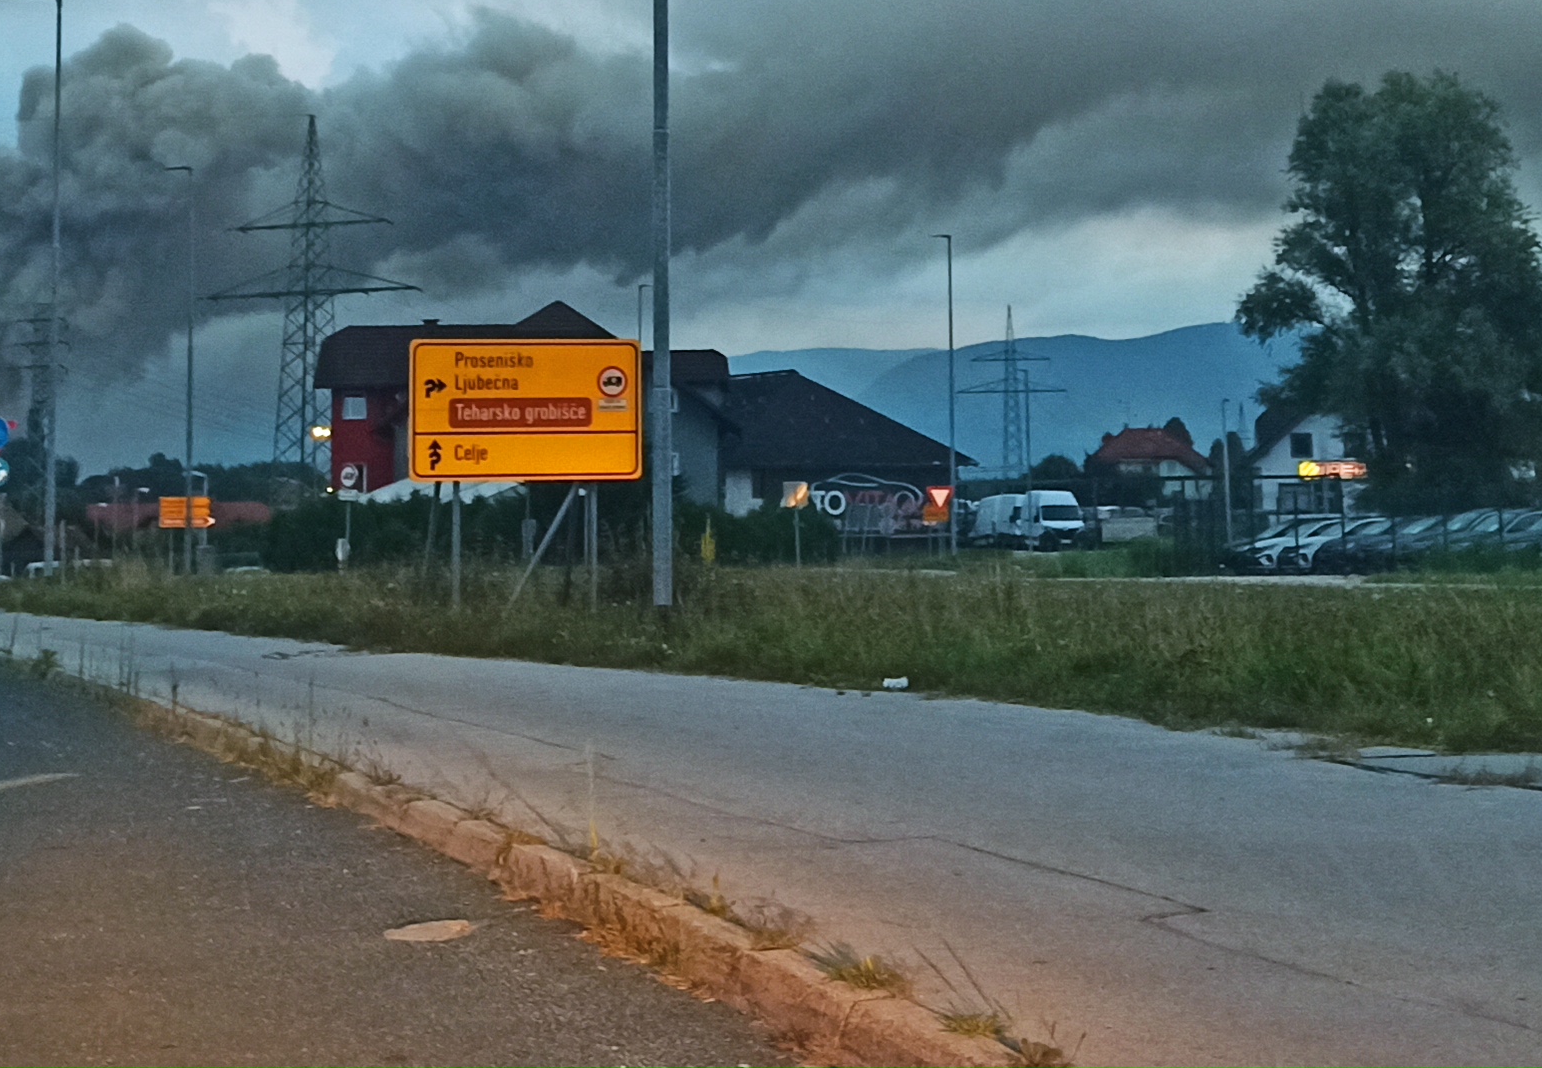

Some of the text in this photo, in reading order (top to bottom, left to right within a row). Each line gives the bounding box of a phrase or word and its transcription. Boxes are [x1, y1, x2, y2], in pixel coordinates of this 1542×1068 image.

[454, 351, 534, 369] Proseniško
[454, 374, 519, 394] Ljubečna
[455, 403, 521, 421] Teharsko
[525, 403, 587, 424] grobišče
[454, 444, 488, 465] Celje
